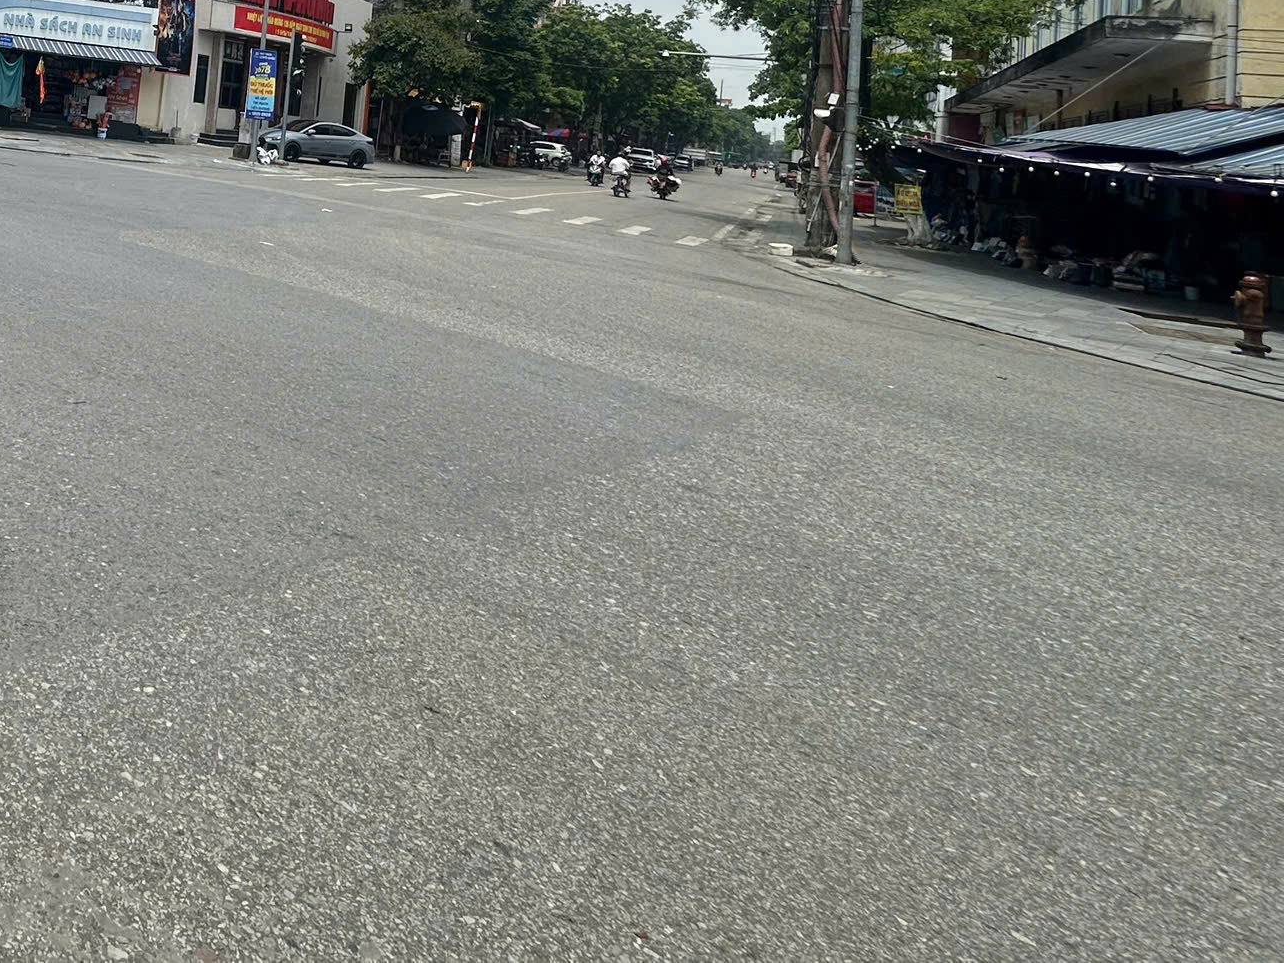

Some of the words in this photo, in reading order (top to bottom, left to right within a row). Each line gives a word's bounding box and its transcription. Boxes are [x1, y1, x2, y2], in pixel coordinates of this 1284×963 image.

[3, 13, 36, 29] NHÀ
[40, 16, 79, 35] SÁCH
[82, 22, 104, 38] AN
[107, 26, 143, 43] SINH
